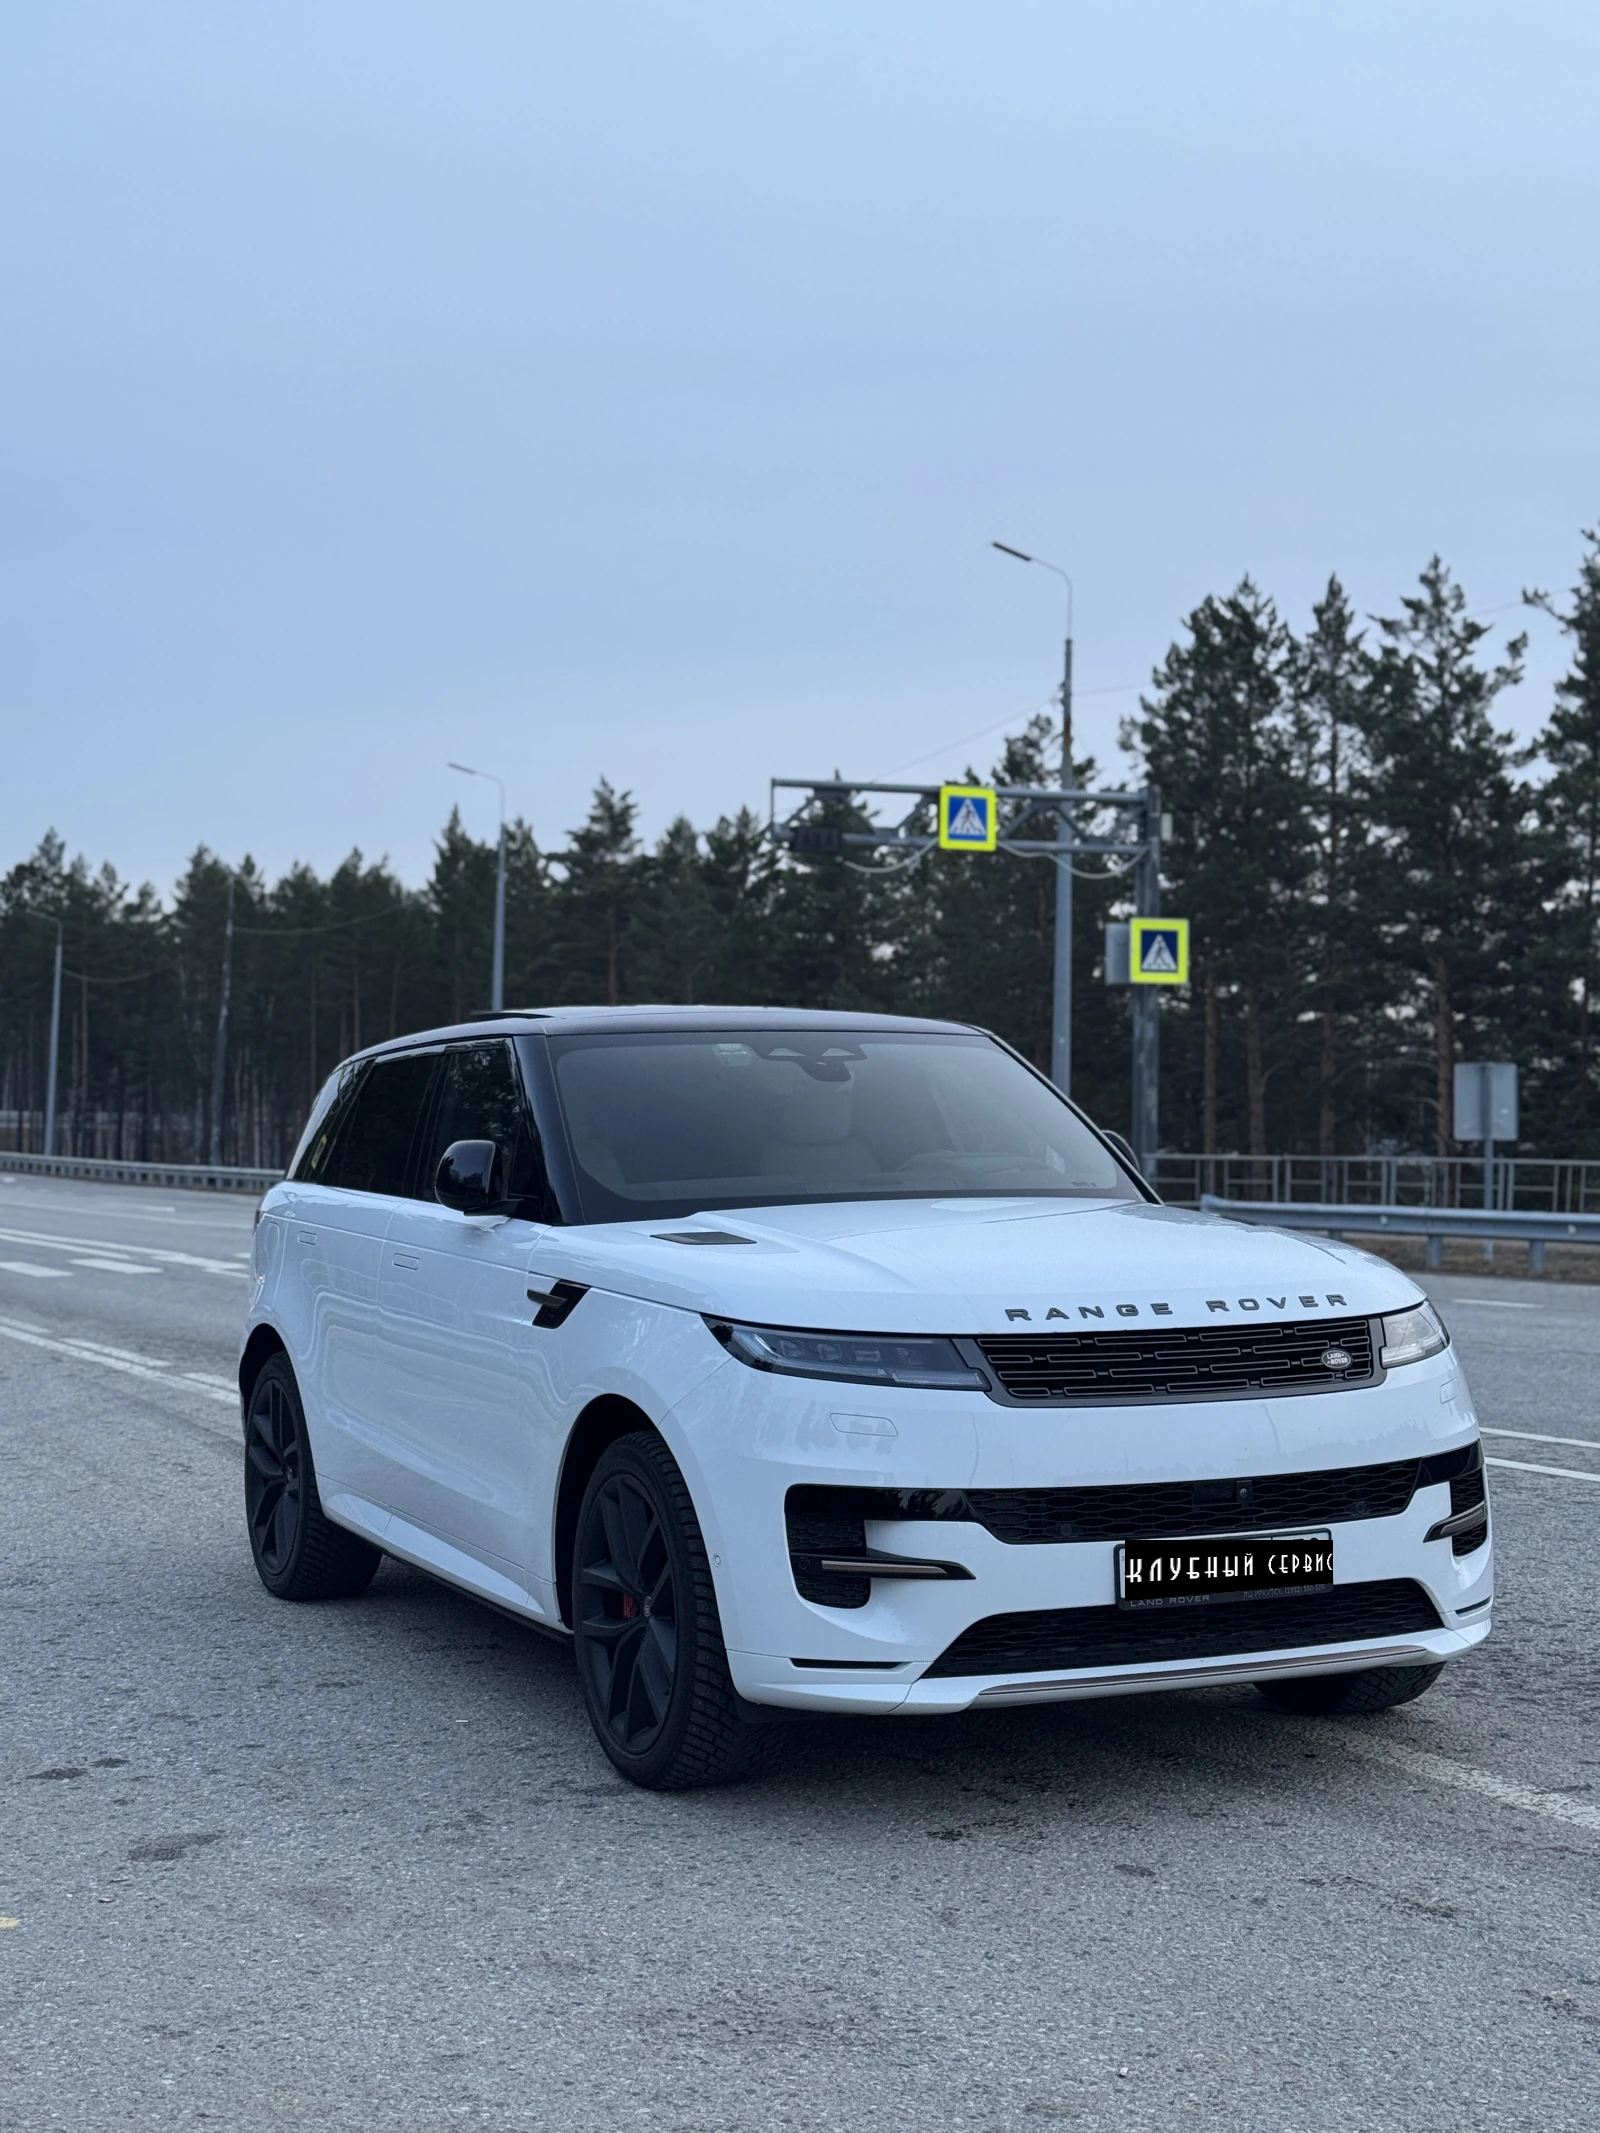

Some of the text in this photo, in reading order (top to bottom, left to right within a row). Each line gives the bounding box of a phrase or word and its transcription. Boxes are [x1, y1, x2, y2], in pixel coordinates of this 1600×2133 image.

[1005, 1293, 1347, 1321] RANGE ROVER
[1330, 1357, 1348, 1365] ROVER
[1130, 1595, 1210, 1607] LAND ROVER
